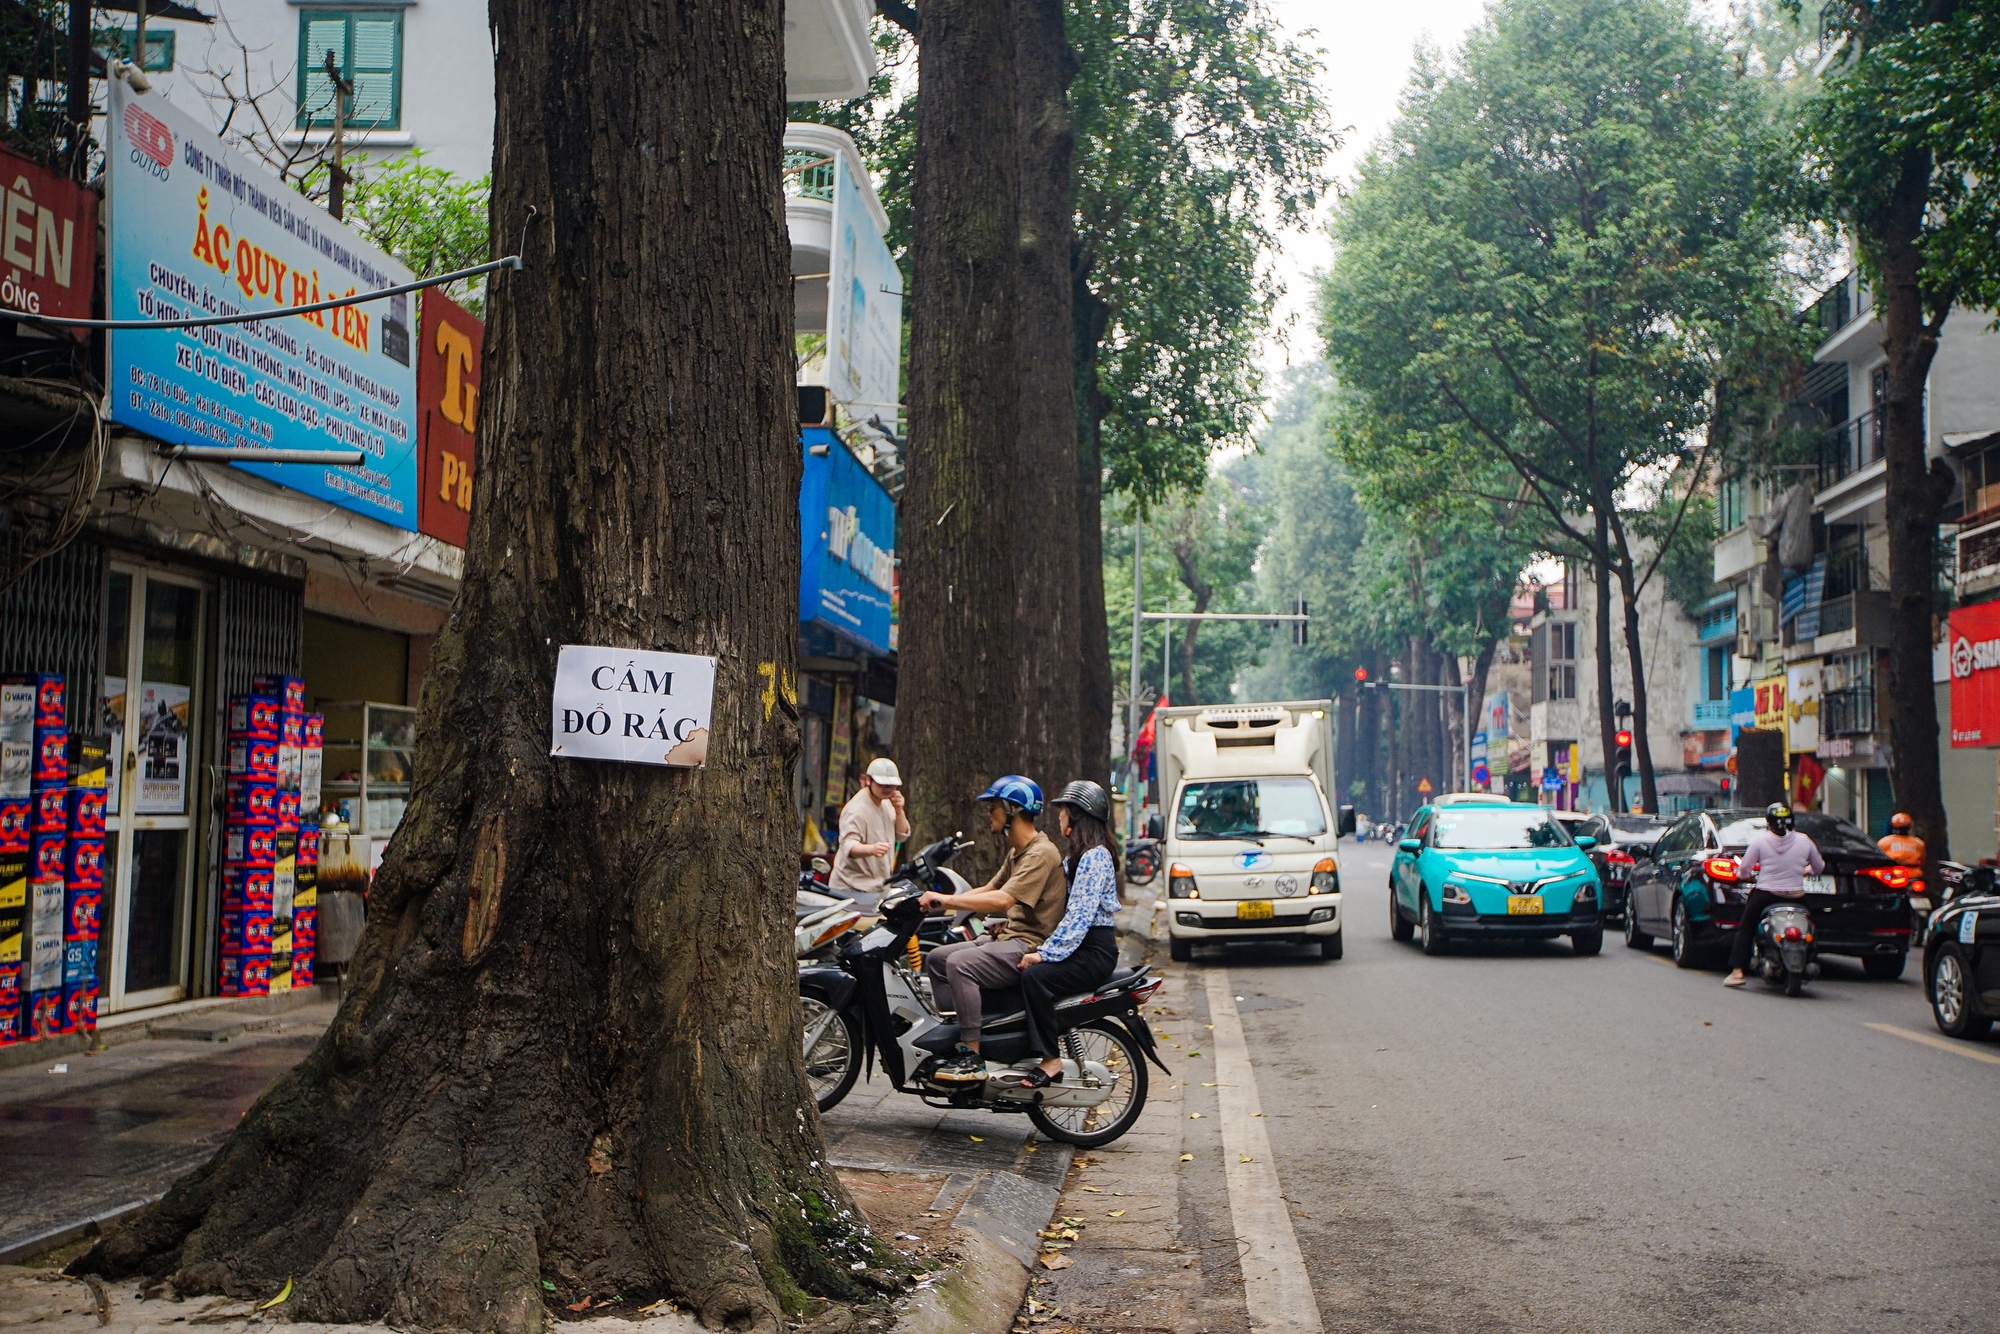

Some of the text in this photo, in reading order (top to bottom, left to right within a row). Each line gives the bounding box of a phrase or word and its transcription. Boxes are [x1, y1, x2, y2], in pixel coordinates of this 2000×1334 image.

[130, 148, 170, 182] OUTDO
[185, 139, 204, 175] CÔNG
[205, 154, 214, 181] TY
[193, 184, 231, 272] ẮC
[236, 237, 287, 305] QUY
[292, 269, 324, 328] HÀ
[328, 286, 369, 355] YẾN
[149, 261, 200, 305] CHUYÊN:
[202, 285, 217, 315] ẮC
[320, 353, 336, 377] QUY
[338, 362, 353, 388] NỘI
[354, 372, 379, 402] NGOẠI
[138, 287, 155, 318] TỔ
[202, 325, 222, 351] QUY
[333, 387, 351, 414] UPS
[359, 402, 371, 423] XE
[371, 408, 389, 431] MÁY
[130, 364, 147, 388] ĐC:
[148, 372, 159, 393] 78
[196, 393, 209, 414] Hai
[176, 342, 192, 373] XE
[194, 348, 203, 376] Ô
[204, 356, 219, 383] TÔ
[220, 363, 246, 397] ĐIỆN
[255, 380, 275, 410] CÁC
[277, 390, 299, 423] LOẠI
[300, 403, 318, 430] SẠC
[325, 414, 343, 444] PHỤ
[367, 431, 374, 455] Ô
[374, 435, 385, 459] TÔ
[130, 391, 142, 412] ĐT
[149, 398, 169, 422] Zalo
[176, 410, 191, 431] 090
[209, 422, 228, 445] 0399
[12, 692, 32, 702] VARTA
[591, 660, 675, 696] CẤM
[562, 703, 698, 743] ĐỔ RÁC
[12, 748, 30, 757] VARTA
[42, 886, 61, 896] VARTA
[42, 940, 59, 949] VARTA
[67, 947, 82, 962] GS
